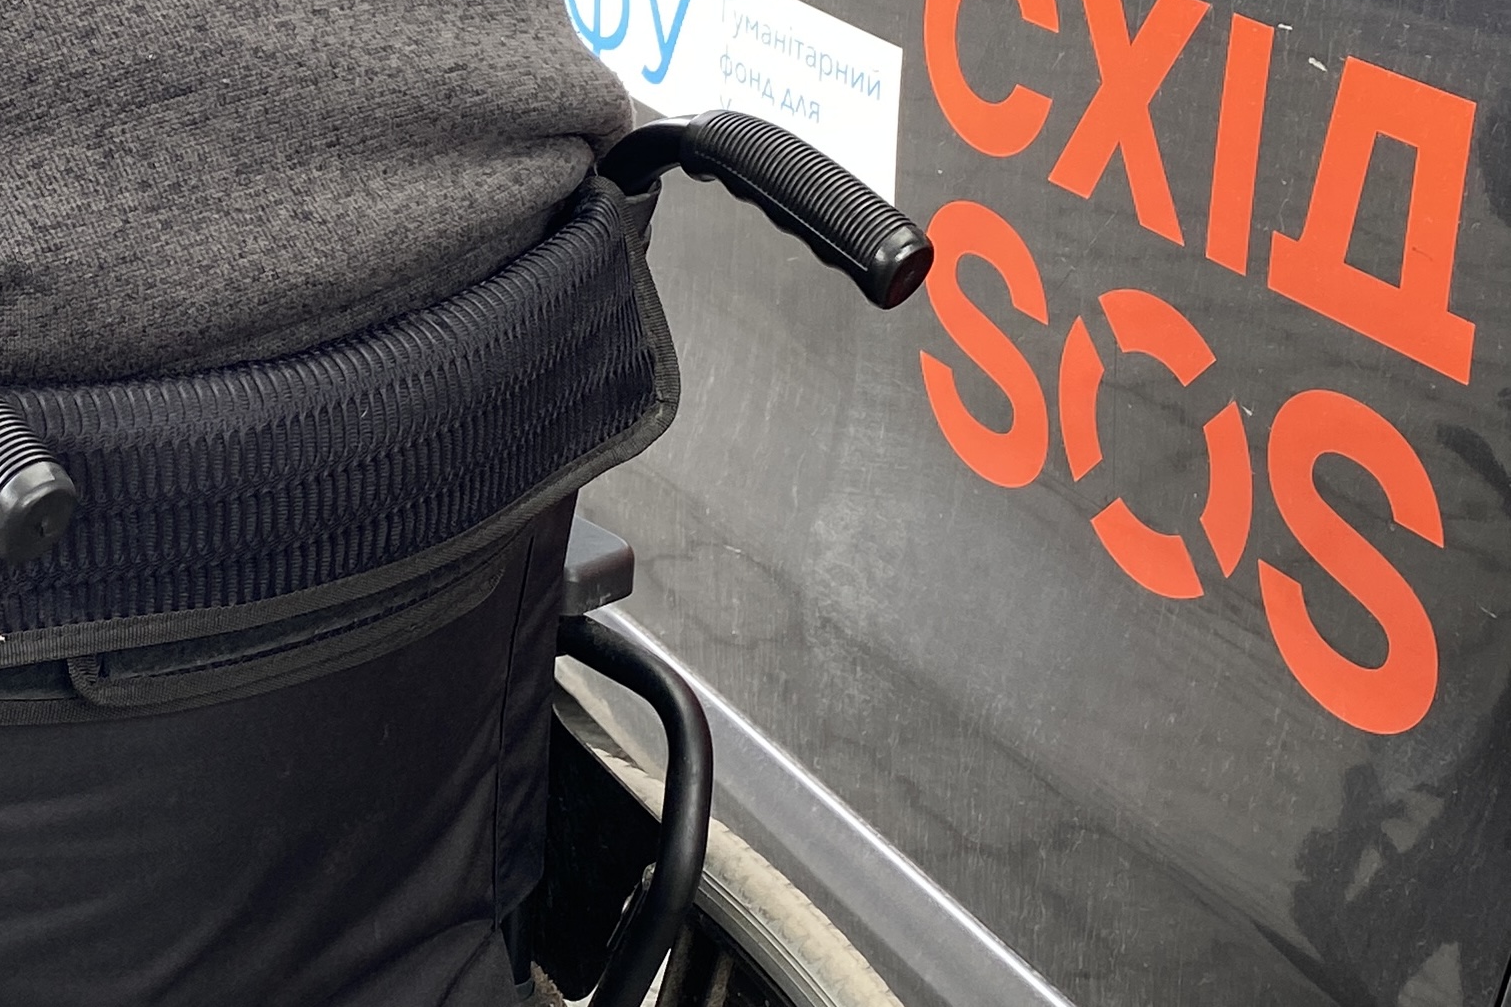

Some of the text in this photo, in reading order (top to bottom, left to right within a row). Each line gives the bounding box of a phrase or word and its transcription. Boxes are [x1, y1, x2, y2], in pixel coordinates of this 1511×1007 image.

[720, 45, 821, 124] фонд для
[919, 200, 1444, 735] SOS
